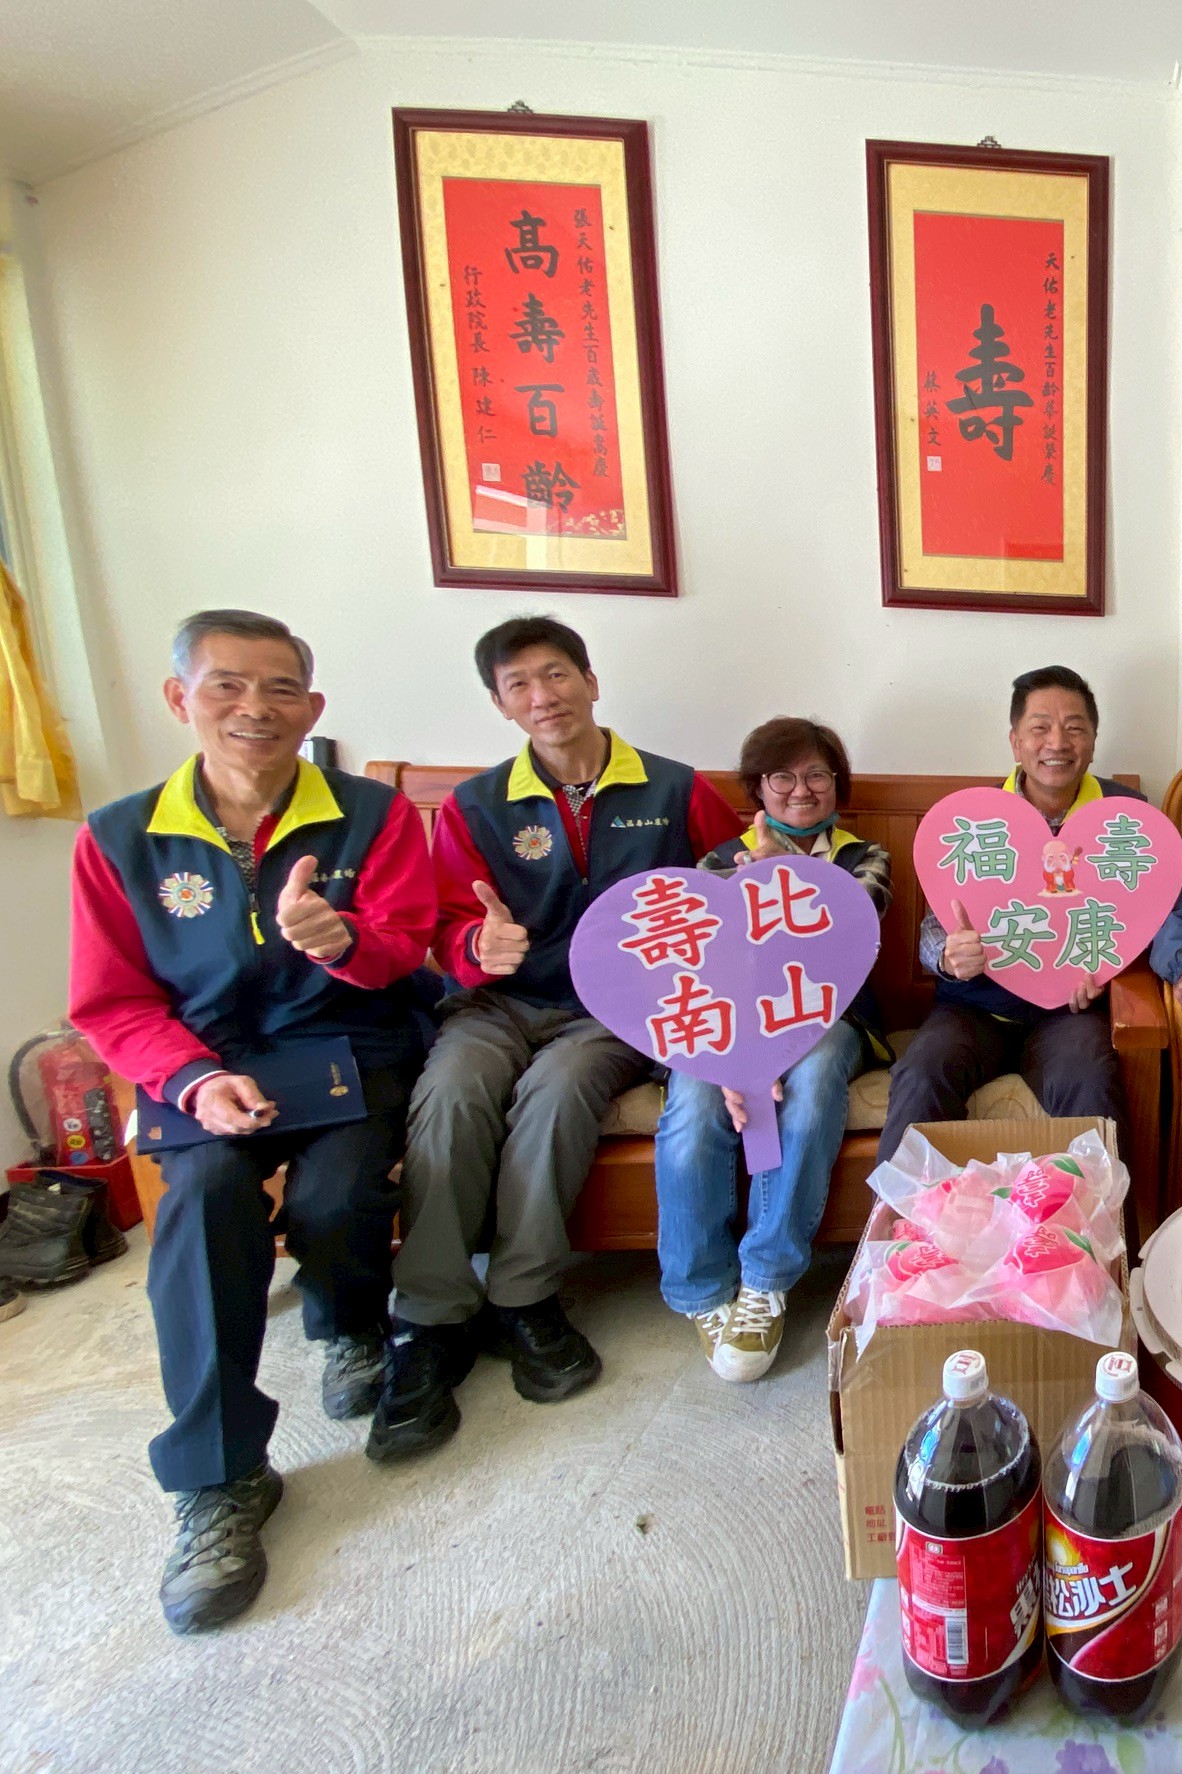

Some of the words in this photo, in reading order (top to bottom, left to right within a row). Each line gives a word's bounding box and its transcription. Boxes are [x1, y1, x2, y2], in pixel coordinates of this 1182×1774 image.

[463, 264, 490, 353] 行政院長
[504, 209, 580, 513] 高壽百齡
[944, 303, 1035, 462] 壽
[924, 371, 941, 446] 蔡英文
[937, 813, 1157, 892] 福壽
[618, 865, 833, 971] 壽比
[981, 898, 1126, 973] 安康
[646, 961, 838, 1061] 南山
